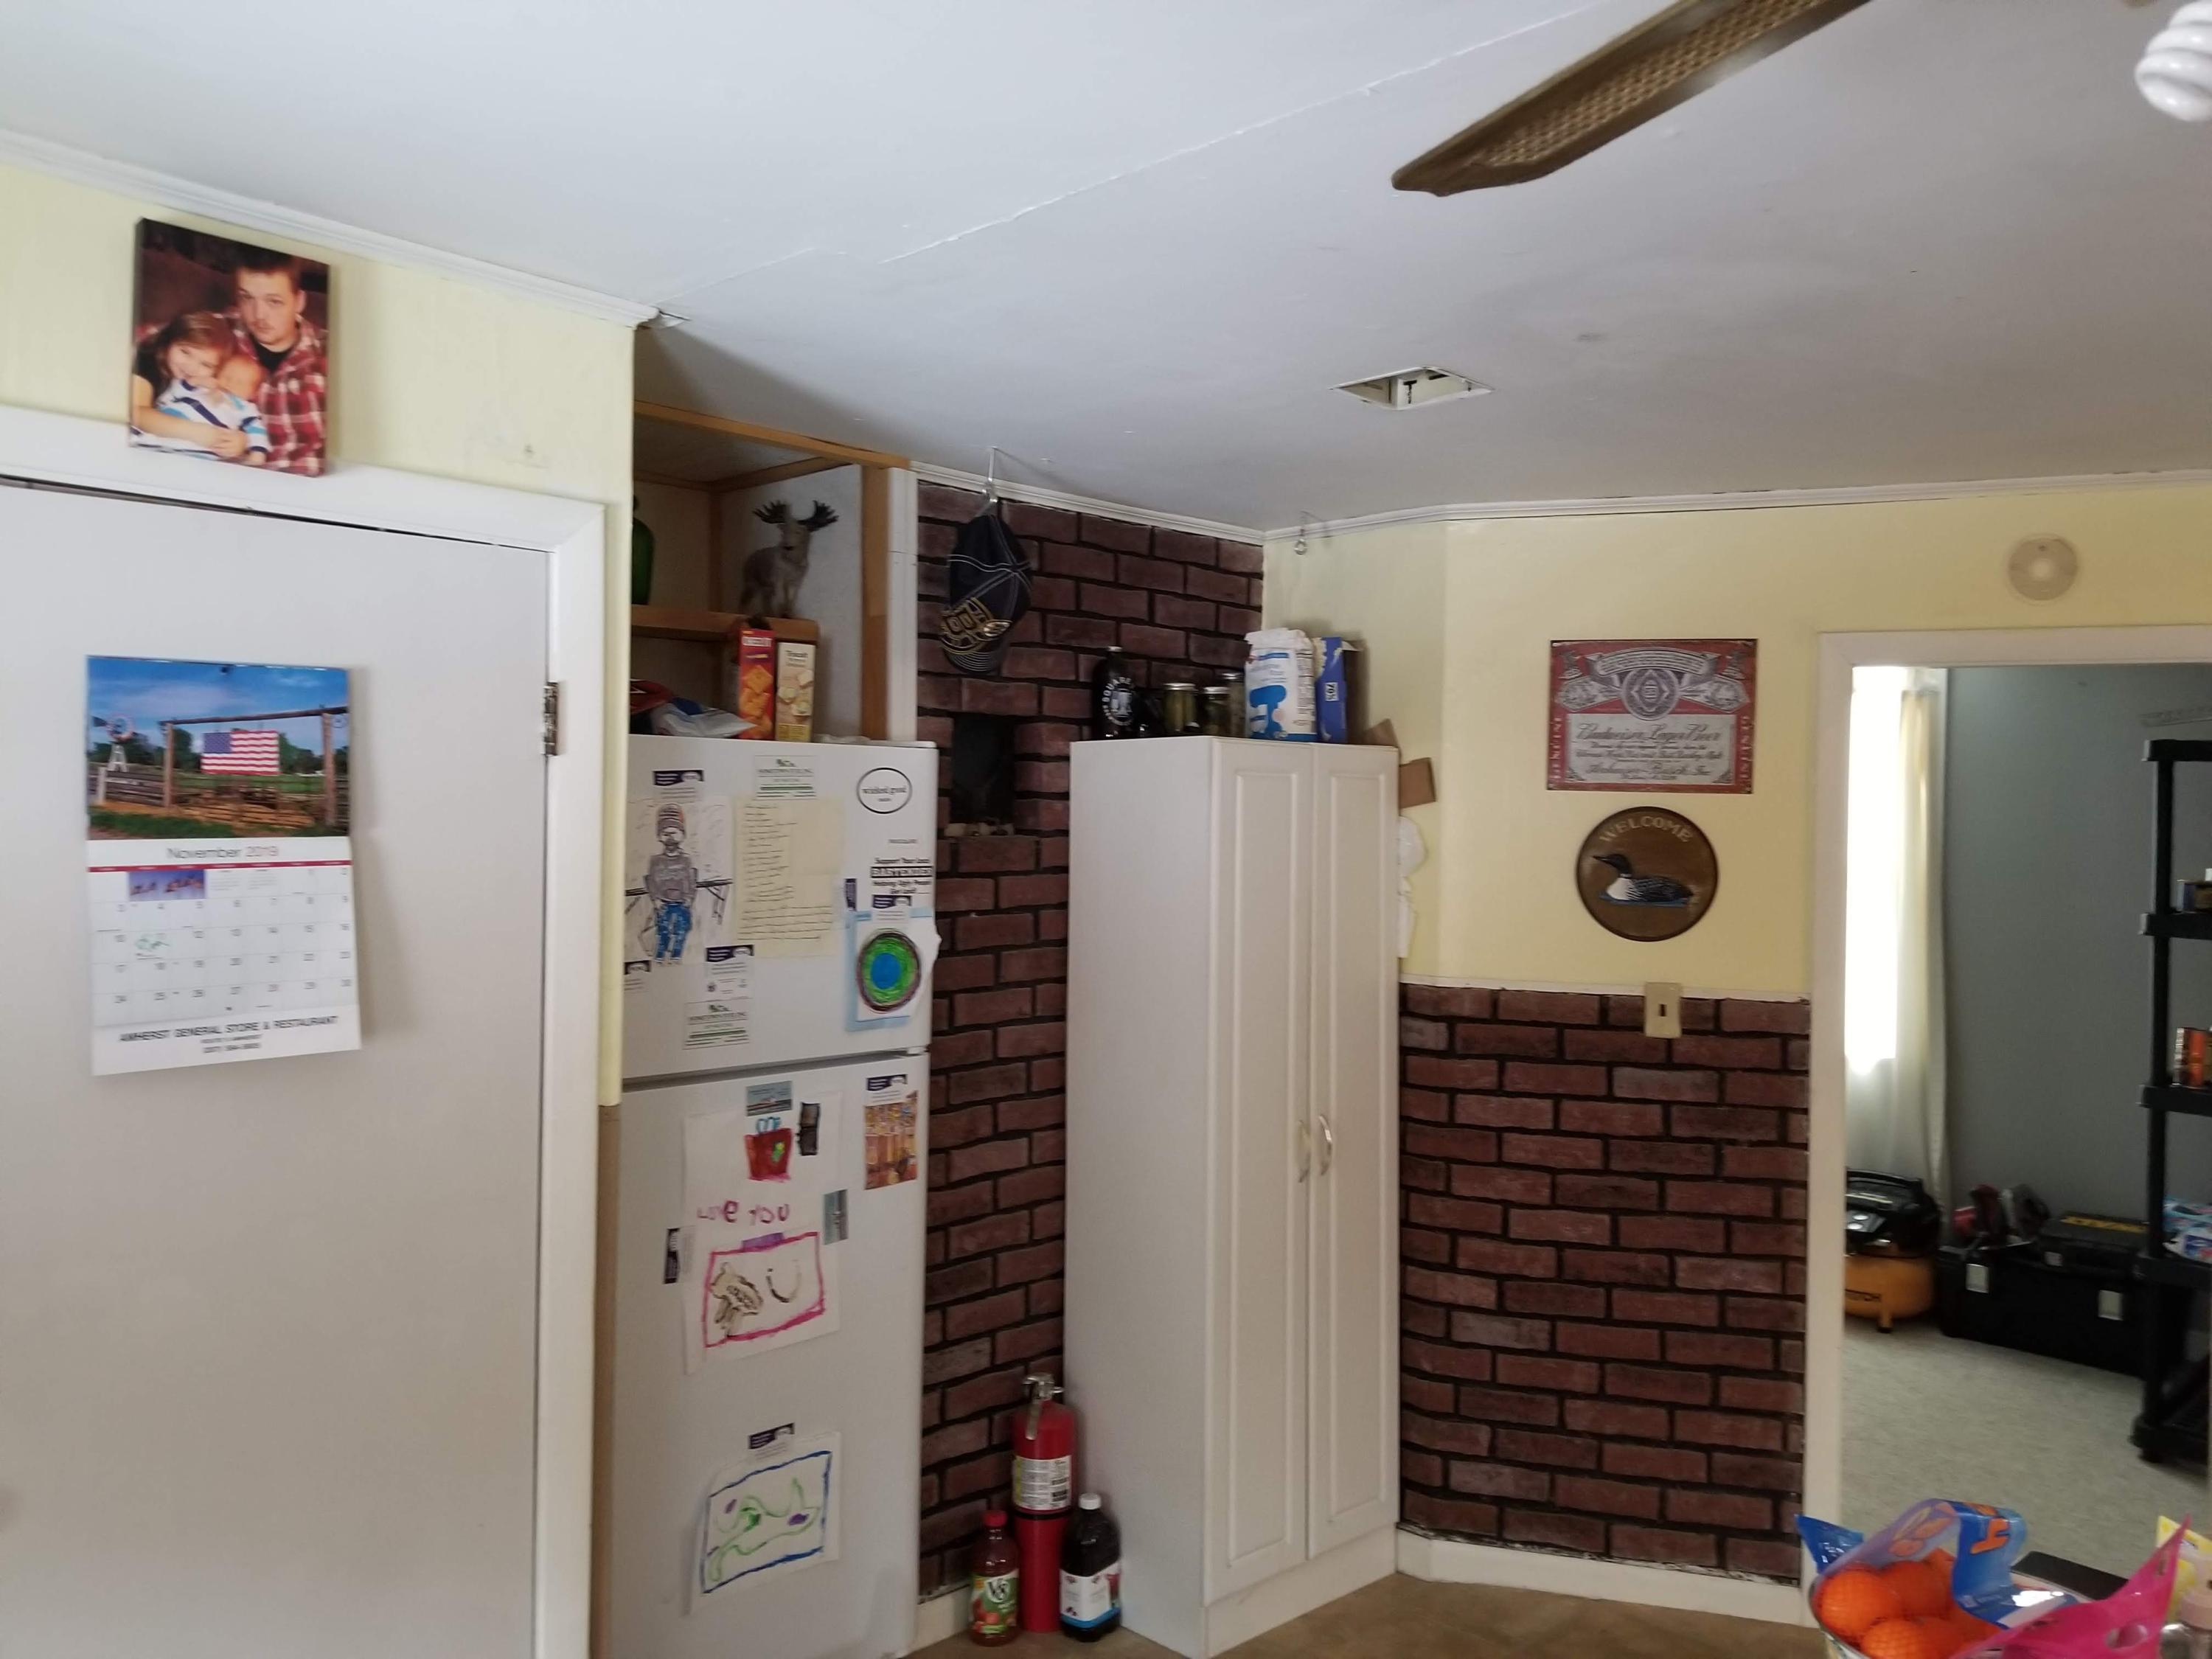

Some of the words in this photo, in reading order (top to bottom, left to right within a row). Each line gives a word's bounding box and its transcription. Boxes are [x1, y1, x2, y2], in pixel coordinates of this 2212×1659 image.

[1599, 815, 1694, 843] WELCOME
[167, 847, 242, 859] November
[119, 1030, 170, 1042] AMHERST
[175, 1026, 223, 1038] GENERAL
[225, 1022, 259, 1033] STORE
[274, 1015, 338, 1029] RESTAURANT
